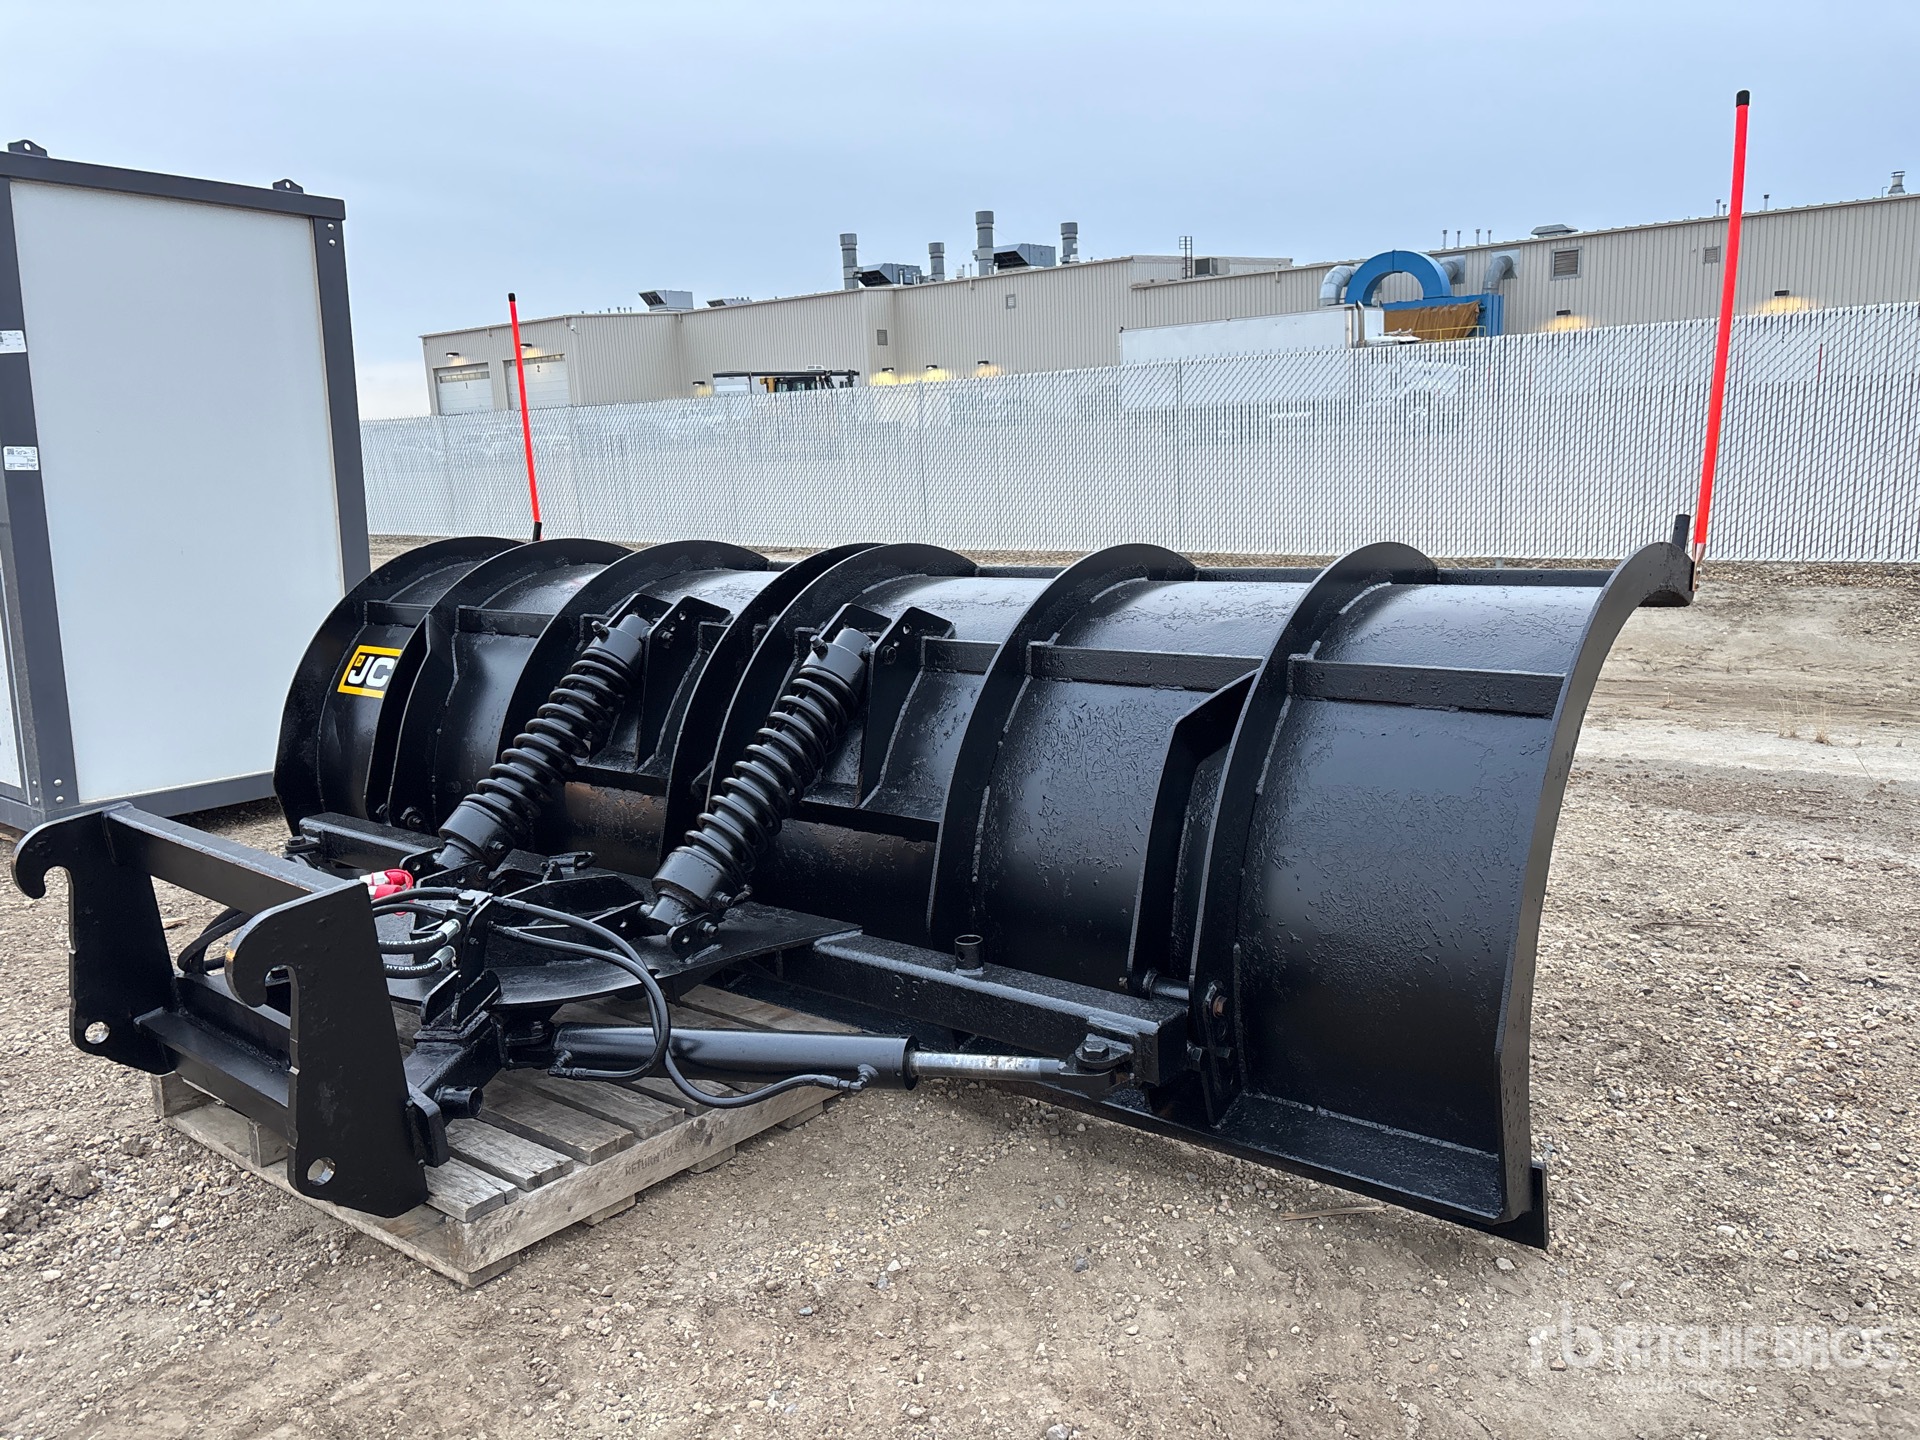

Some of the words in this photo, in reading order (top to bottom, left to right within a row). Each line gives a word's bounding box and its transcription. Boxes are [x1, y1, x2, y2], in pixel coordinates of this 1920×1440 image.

[536, 364, 541, 372] 2
[347, 655, 396, 688] JC
[386, 959, 439, 971] HYDROWORKS
[625, 1152, 661, 1177] RETURN
